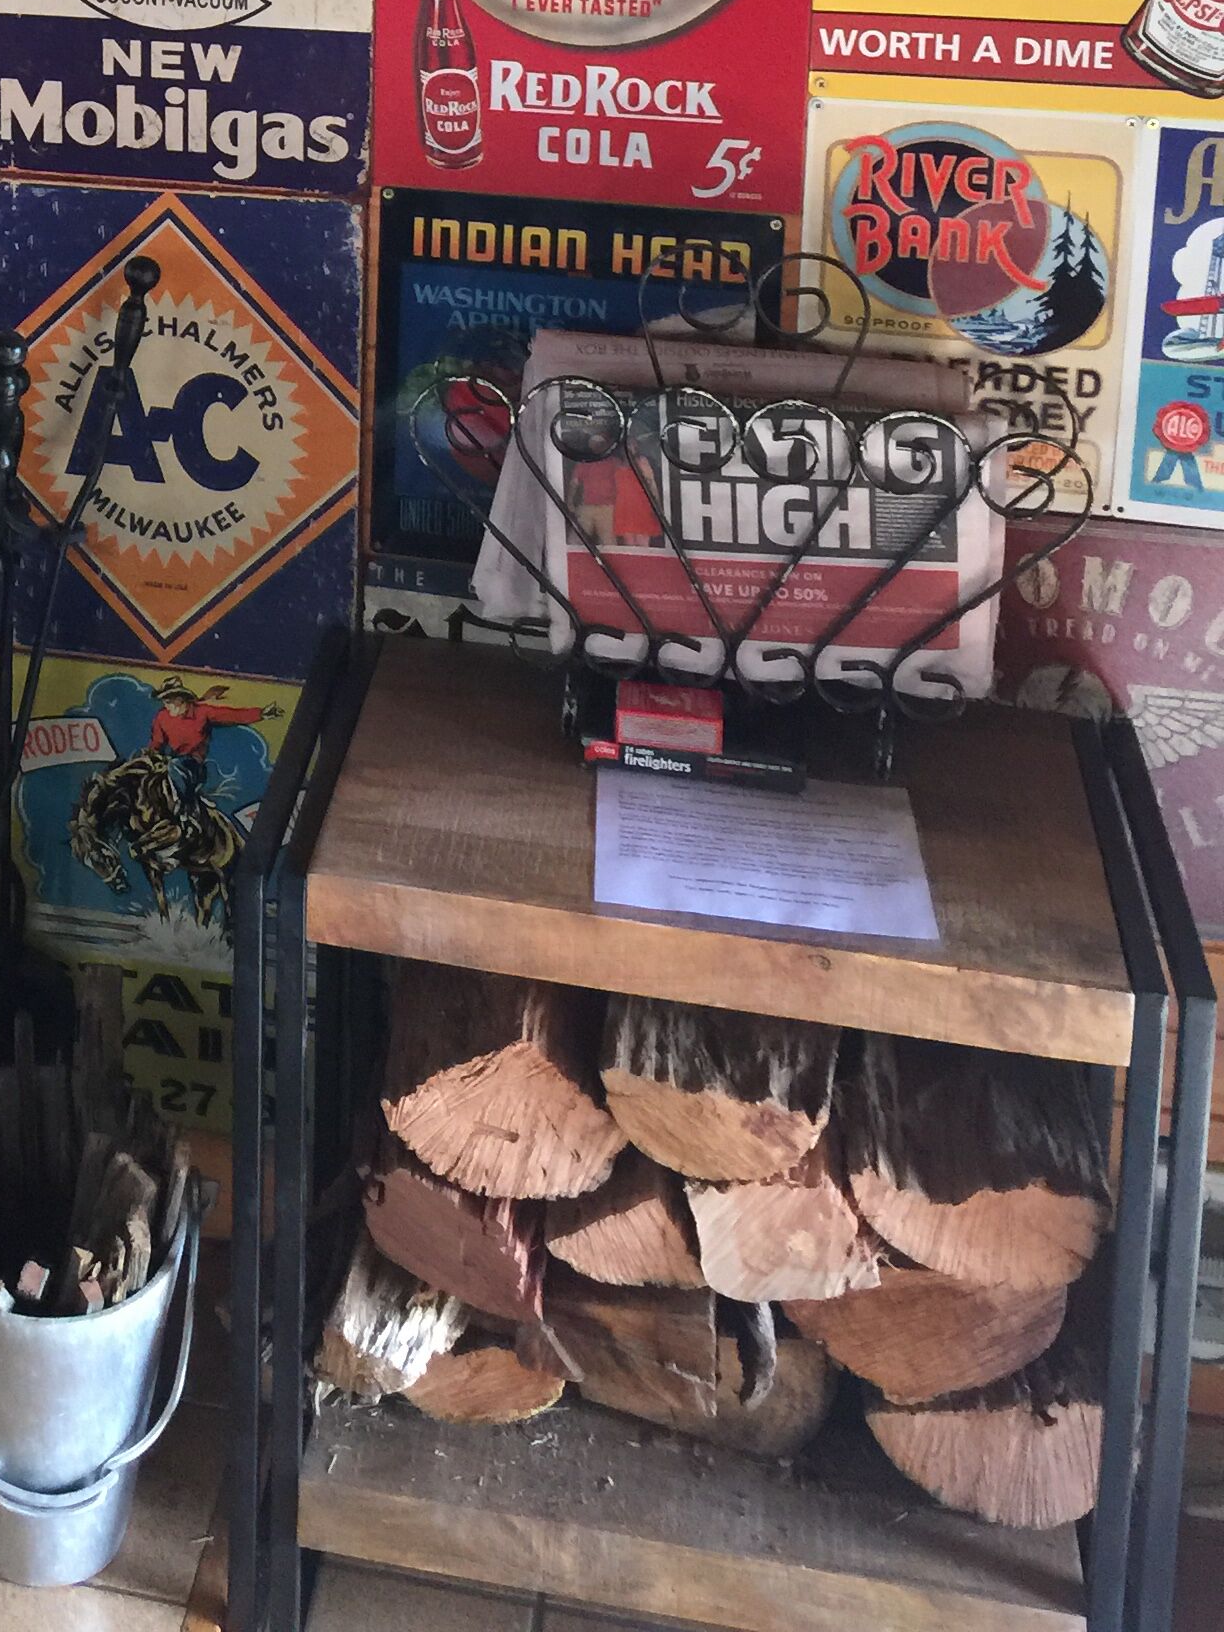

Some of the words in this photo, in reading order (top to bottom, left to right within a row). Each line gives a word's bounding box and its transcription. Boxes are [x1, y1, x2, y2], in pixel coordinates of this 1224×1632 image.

[102, 37, 243, 83] NEW
[819, 27, 961, 61] WORTH
[973, 35, 1002, 64] A
[1014, 36, 1114, 70] DIME
[0, 77, 352, 180] Mobilgas
[436, 120, 470, 133] COLA
[537, 126, 654, 169] COLA
[843, 135, 1034, 229] RIVER
[412, 216, 588, 270] INDIAN
[612, 231, 753, 285] HEAD
[842, 203, 1049, 292] BANK
[412, 282, 608, 321] WASHINGTON
[54, 331, 116, 415] ALLIS
[85, 486, 246, 544] MILWAUKEE
[679, 479, 872, 551] HIGH
[737, 584, 761, 599] UP
[792, 587, 829, 602] 50%
[623, 752, 692, 774] firelighters
